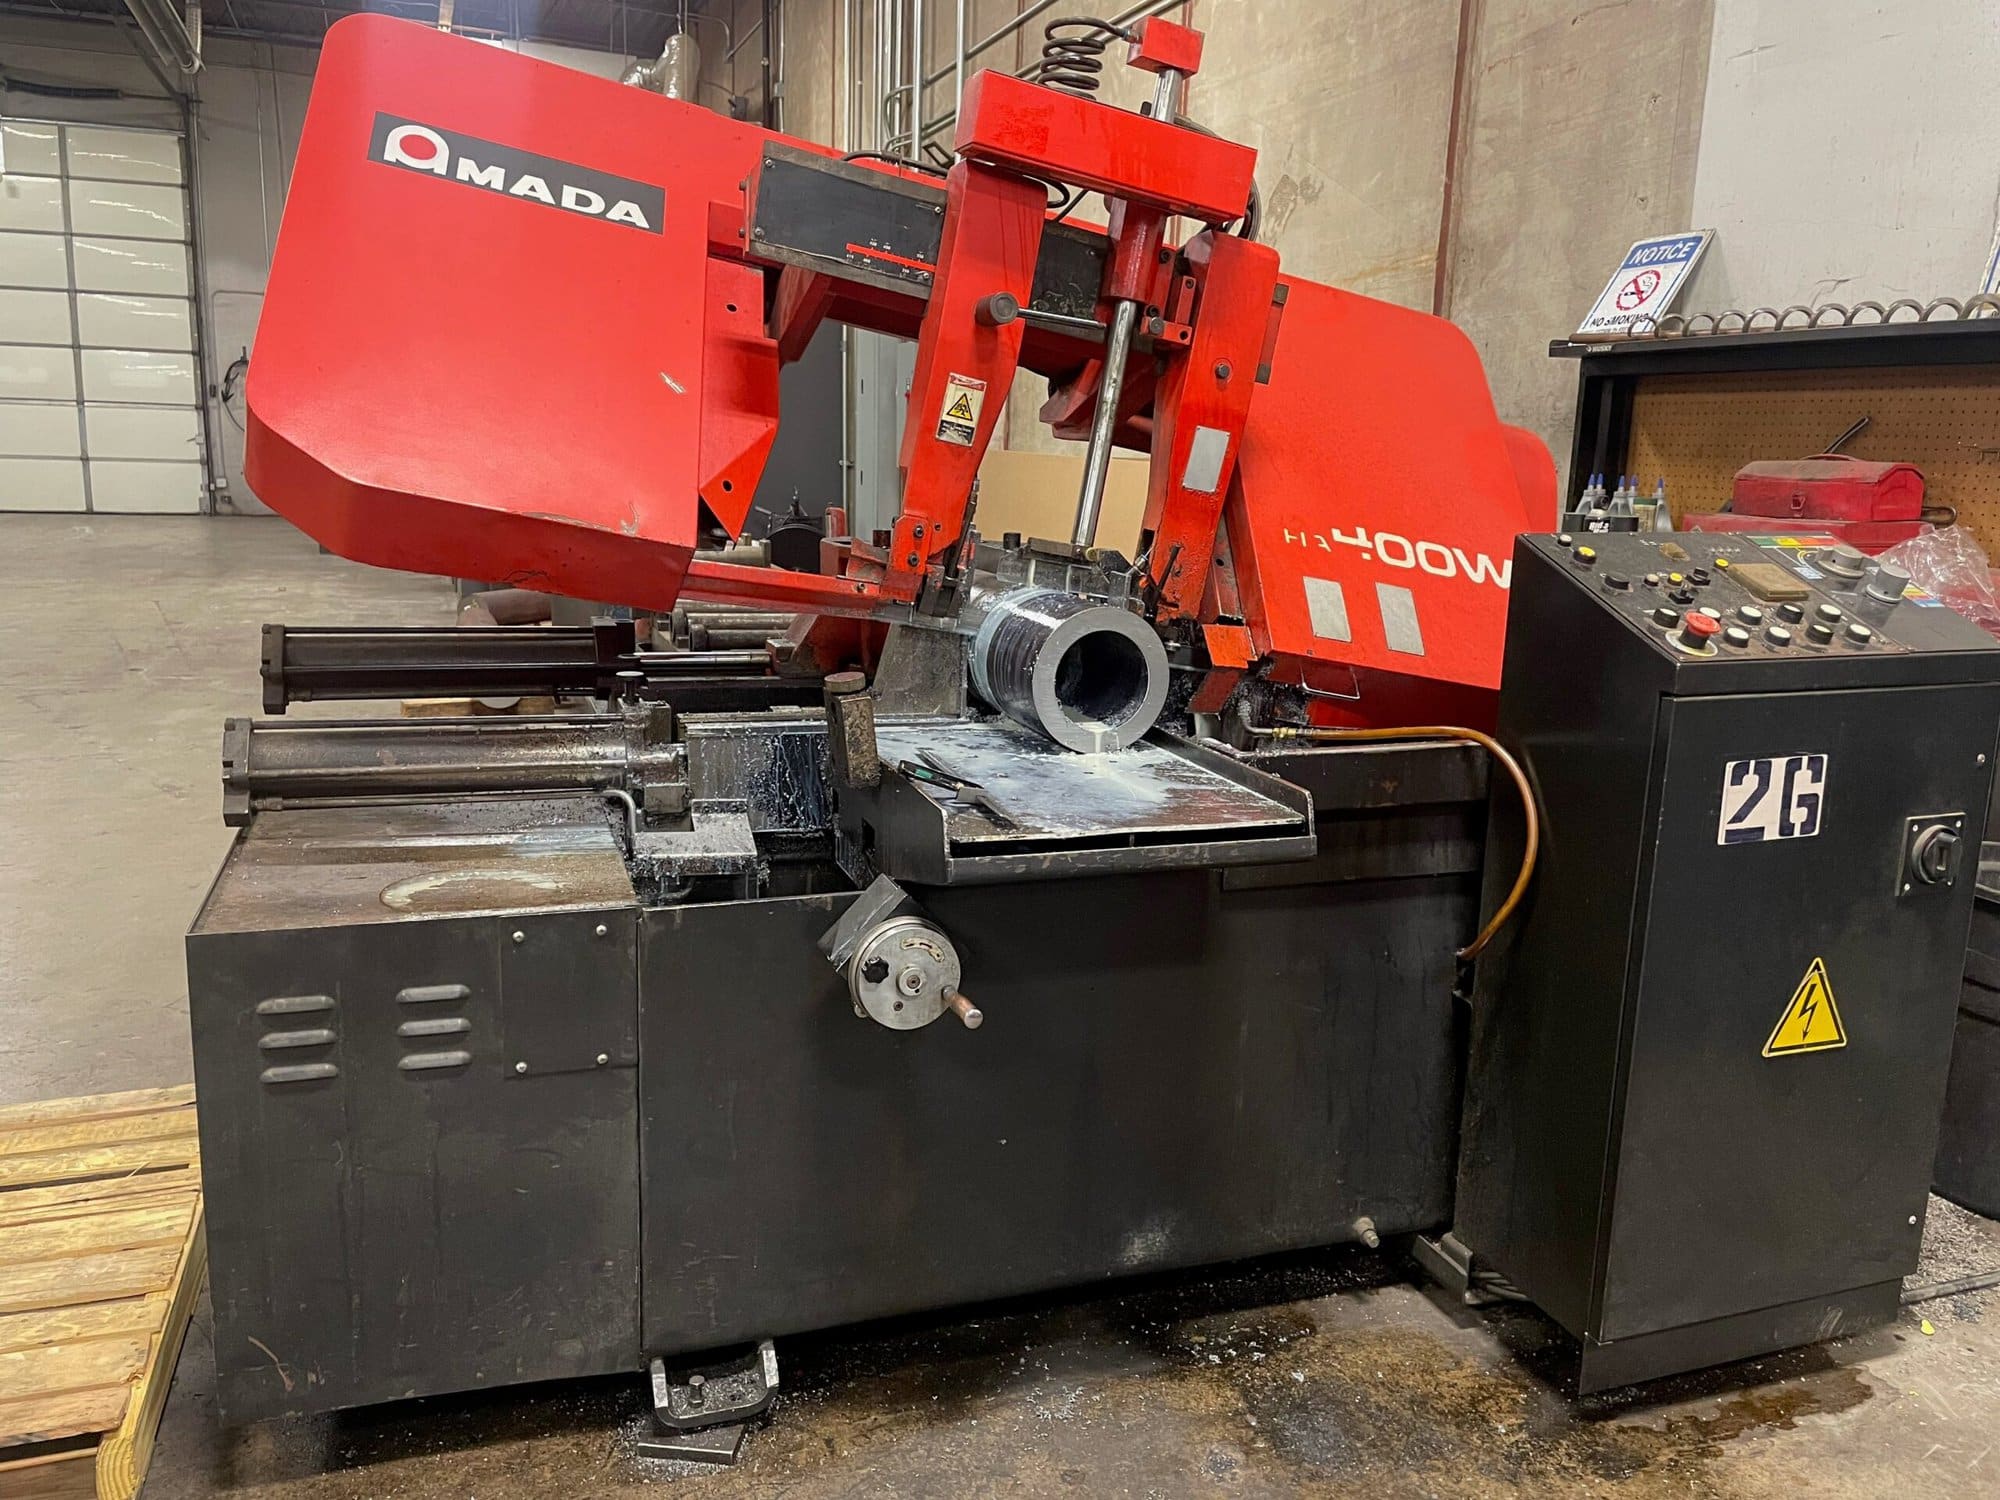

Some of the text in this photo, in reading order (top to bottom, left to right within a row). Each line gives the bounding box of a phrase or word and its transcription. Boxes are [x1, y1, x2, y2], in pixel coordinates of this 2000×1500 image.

[383, 124, 650, 228] AMADA
[1628, 241, 1697, 264] NOTICE
[1590, 317, 1605, 327] NO
